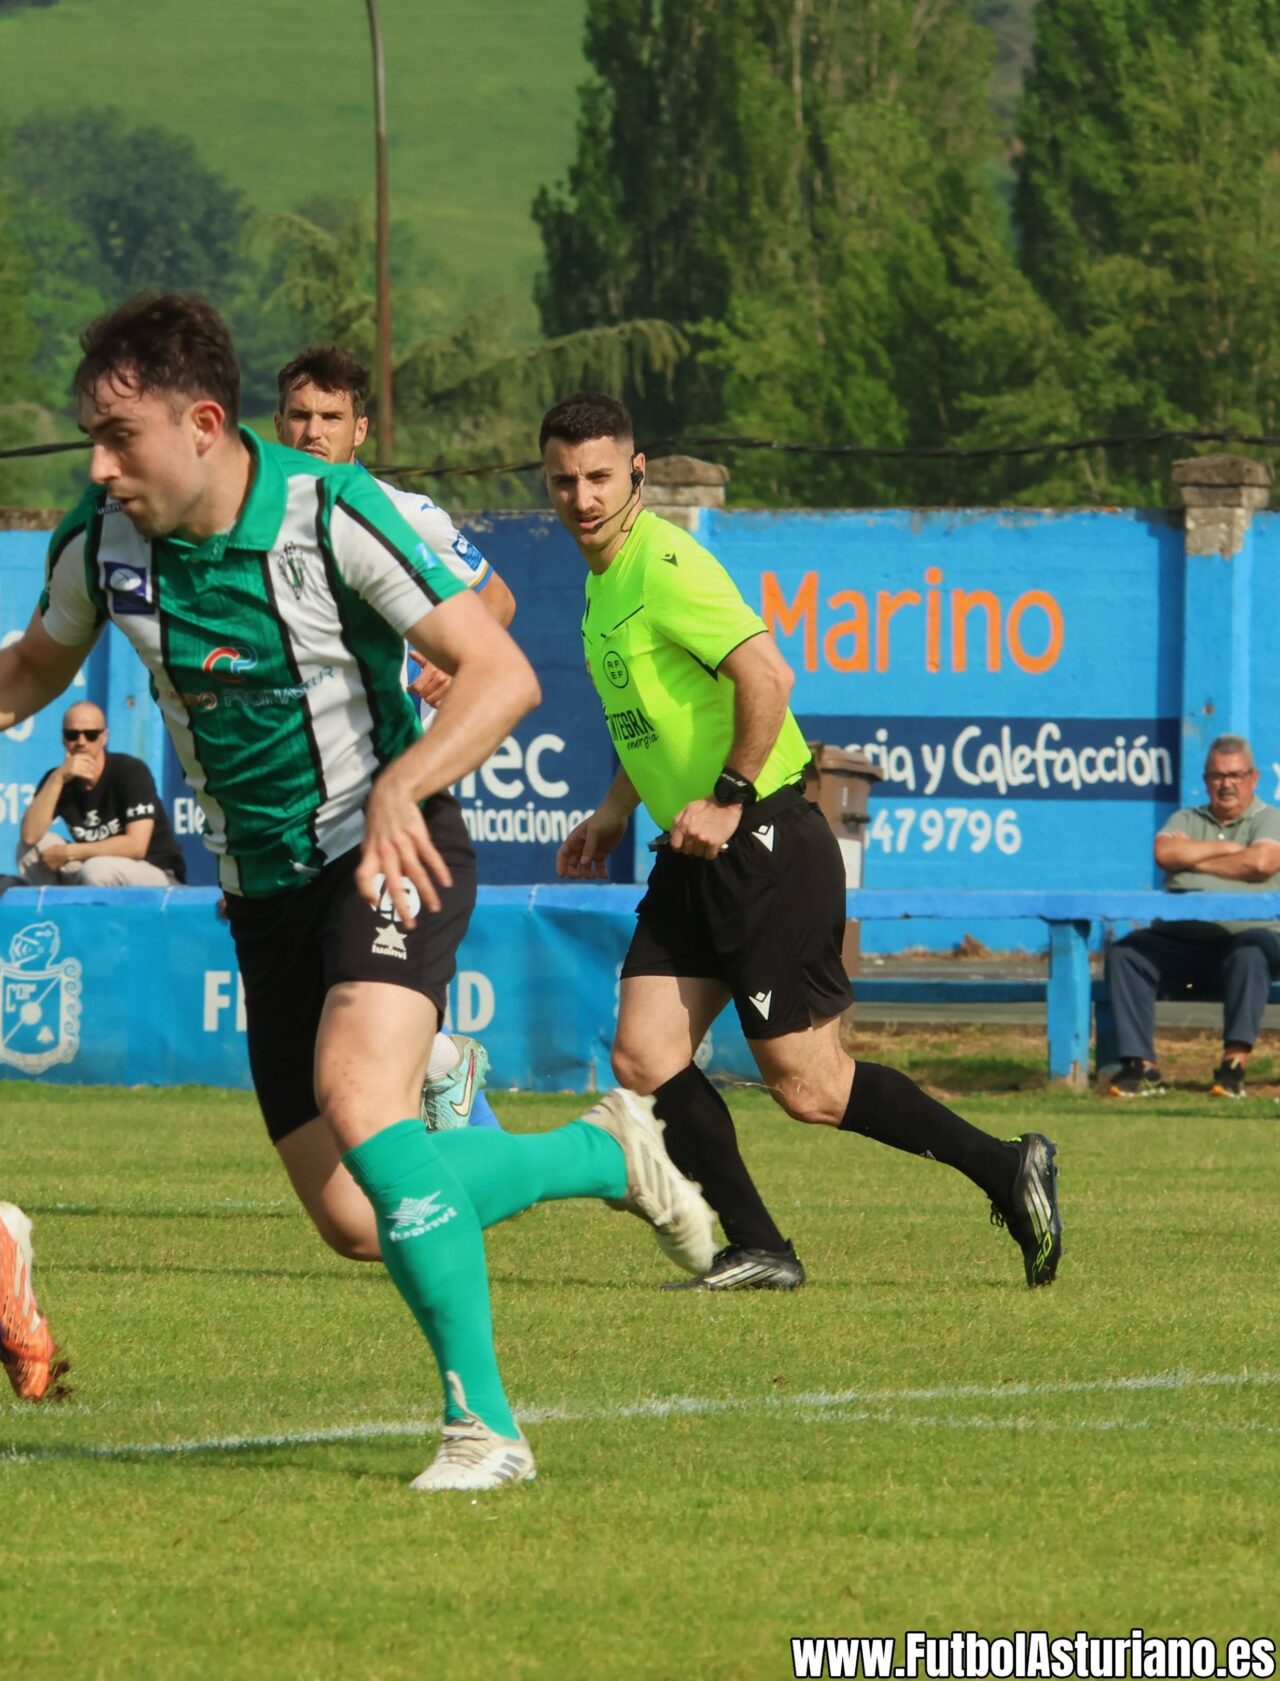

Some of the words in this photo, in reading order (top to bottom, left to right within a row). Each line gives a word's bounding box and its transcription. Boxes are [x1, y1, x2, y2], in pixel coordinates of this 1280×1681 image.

[761, 566, 1065, 674] Marino
[846, 728, 916, 792] ria
[921, 743, 946, 796] y
[952, 722, 1173, 796] Calefacción
[864, 807, 1022, 855] 479796
